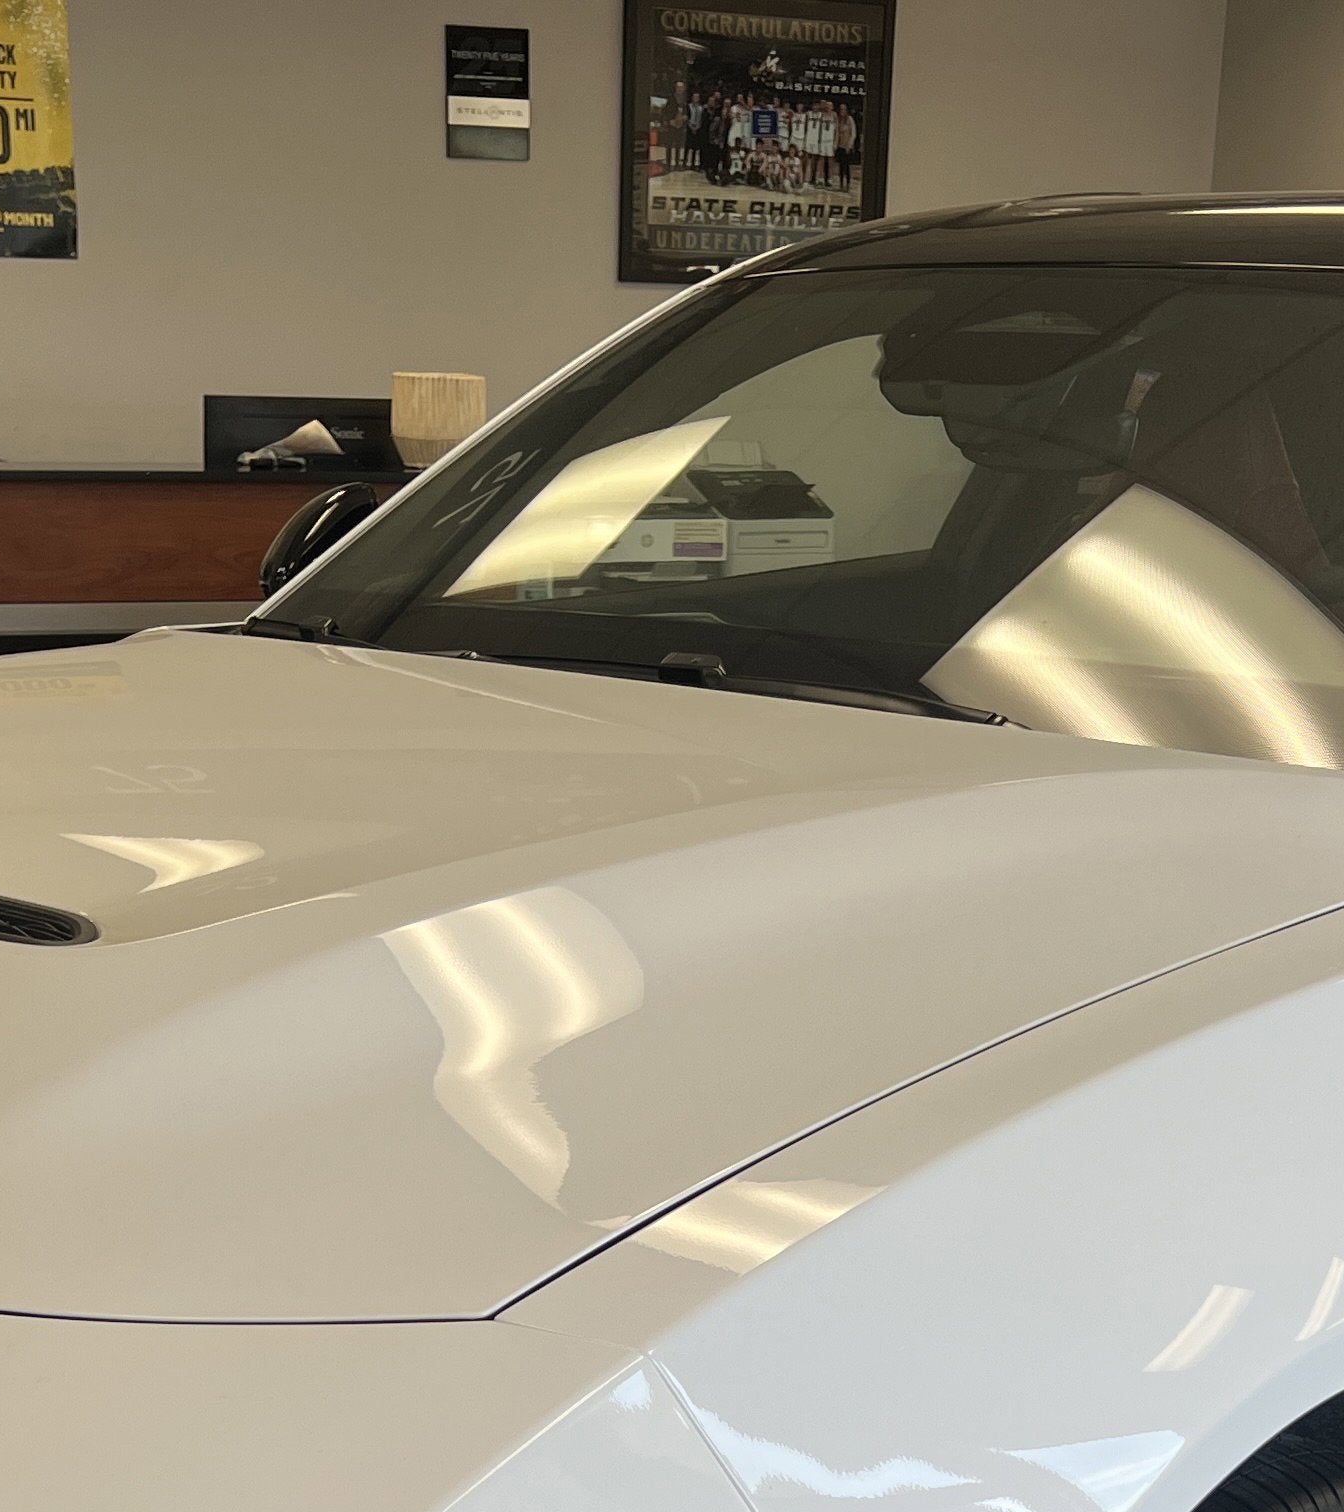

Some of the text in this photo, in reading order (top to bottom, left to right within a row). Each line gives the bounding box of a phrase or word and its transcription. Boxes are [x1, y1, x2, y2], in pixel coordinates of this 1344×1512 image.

[660, 10, 864, 45] CONGRATULATIONS
[3, 211, 54, 227] MONTH
[651, 196, 861, 220] STATE CHAMPS
[670, 209, 844, 231] HAYESVILLE
